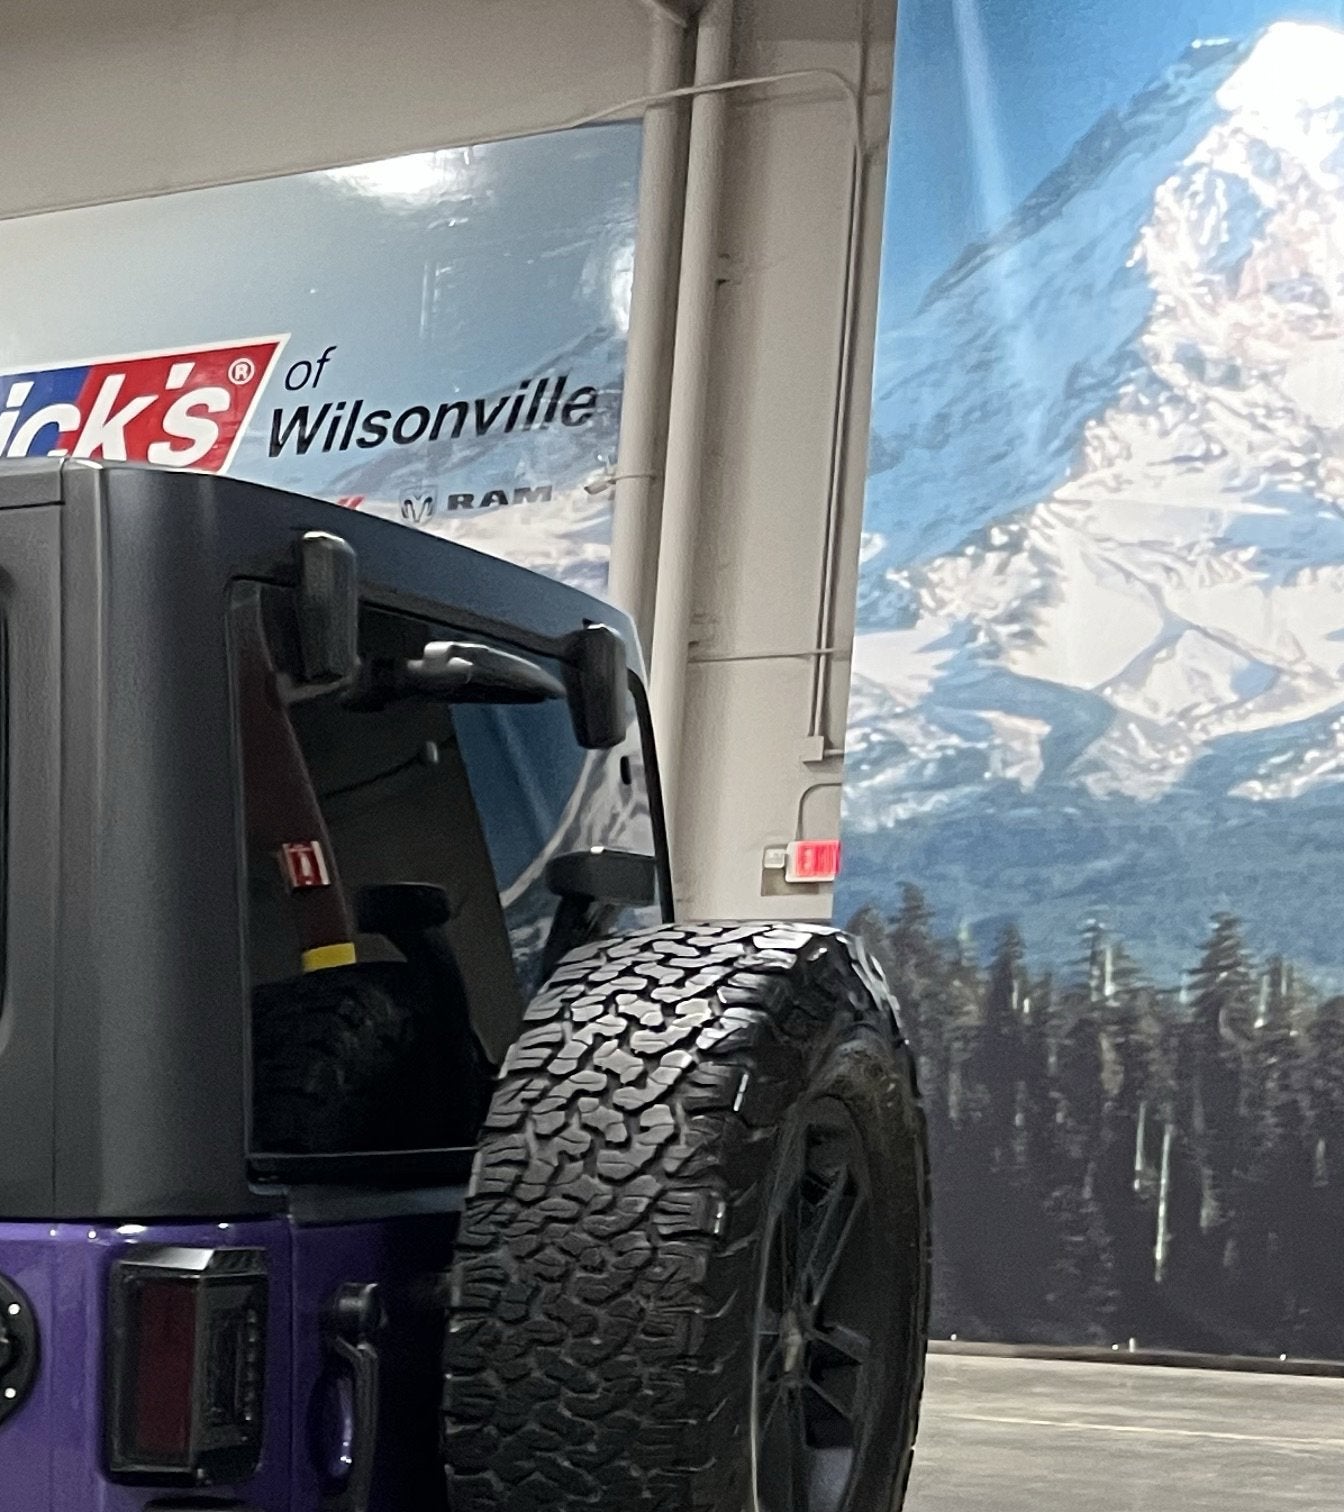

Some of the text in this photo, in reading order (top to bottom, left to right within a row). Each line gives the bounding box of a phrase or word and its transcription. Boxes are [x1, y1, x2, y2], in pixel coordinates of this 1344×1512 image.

[285, 346, 337, 391] of
[268, 374, 598, 458] Wilsonville
[447, 485, 553, 512] RAM
